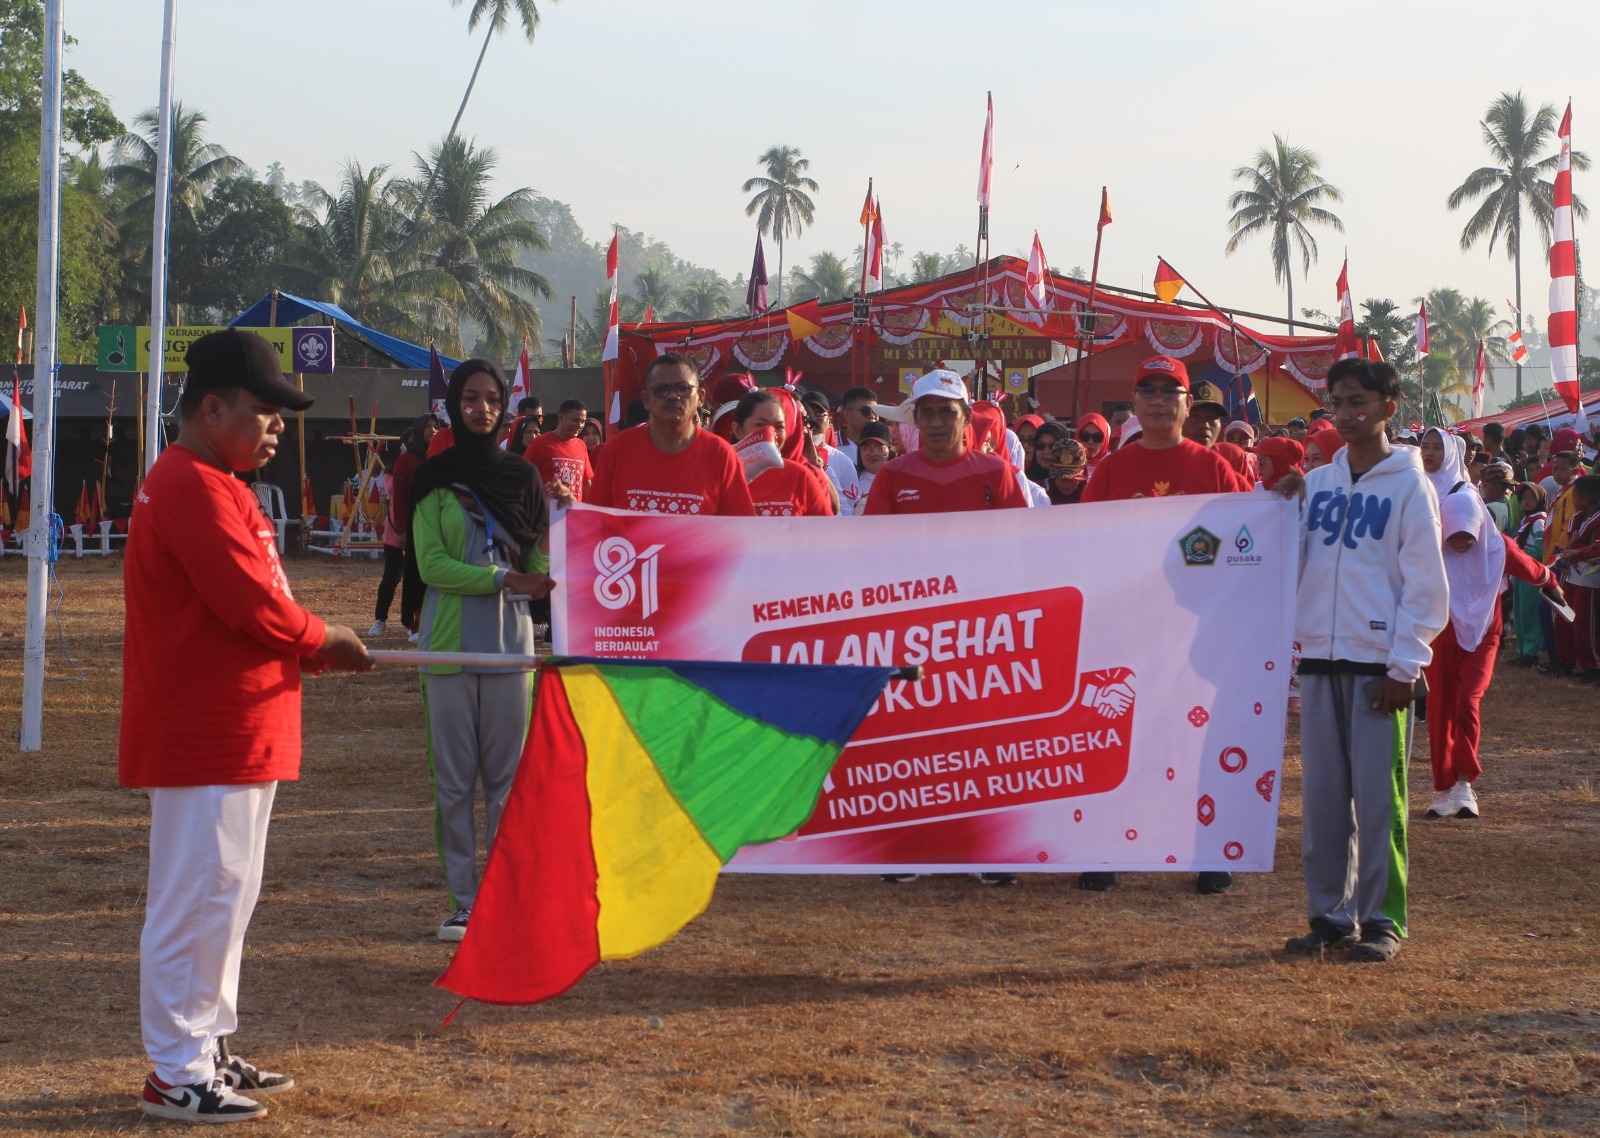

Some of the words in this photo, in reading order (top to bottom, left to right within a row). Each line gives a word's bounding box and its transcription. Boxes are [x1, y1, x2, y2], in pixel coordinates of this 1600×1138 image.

[883, 349, 900, 360] MI
[907, 349, 942, 360] SITI
[950, 349, 993, 360] HAWA
[1002, 349, 1048, 360] BUKO
[401, 379, 418, 387] MI
[593, 536, 667, 620] 81
[1226, 554, 1262, 566] pusaka
[753, 590, 855, 623] KEMENAG
[861, 575, 958, 607] BOLTARA
[594, 626, 655, 638] INDONESIA
[594, 641, 660, 652] BERDAULAT
[903, 608, 1043, 664] SEHAT
[866, 658, 1043, 717] KUNAN
[846, 748, 991, 787] INDONESIA
[995, 728, 1122, 764] MERDEKA
[828, 779, 981, 820] INDONESIA
[987, 763, 1085, 796] RUKUN
